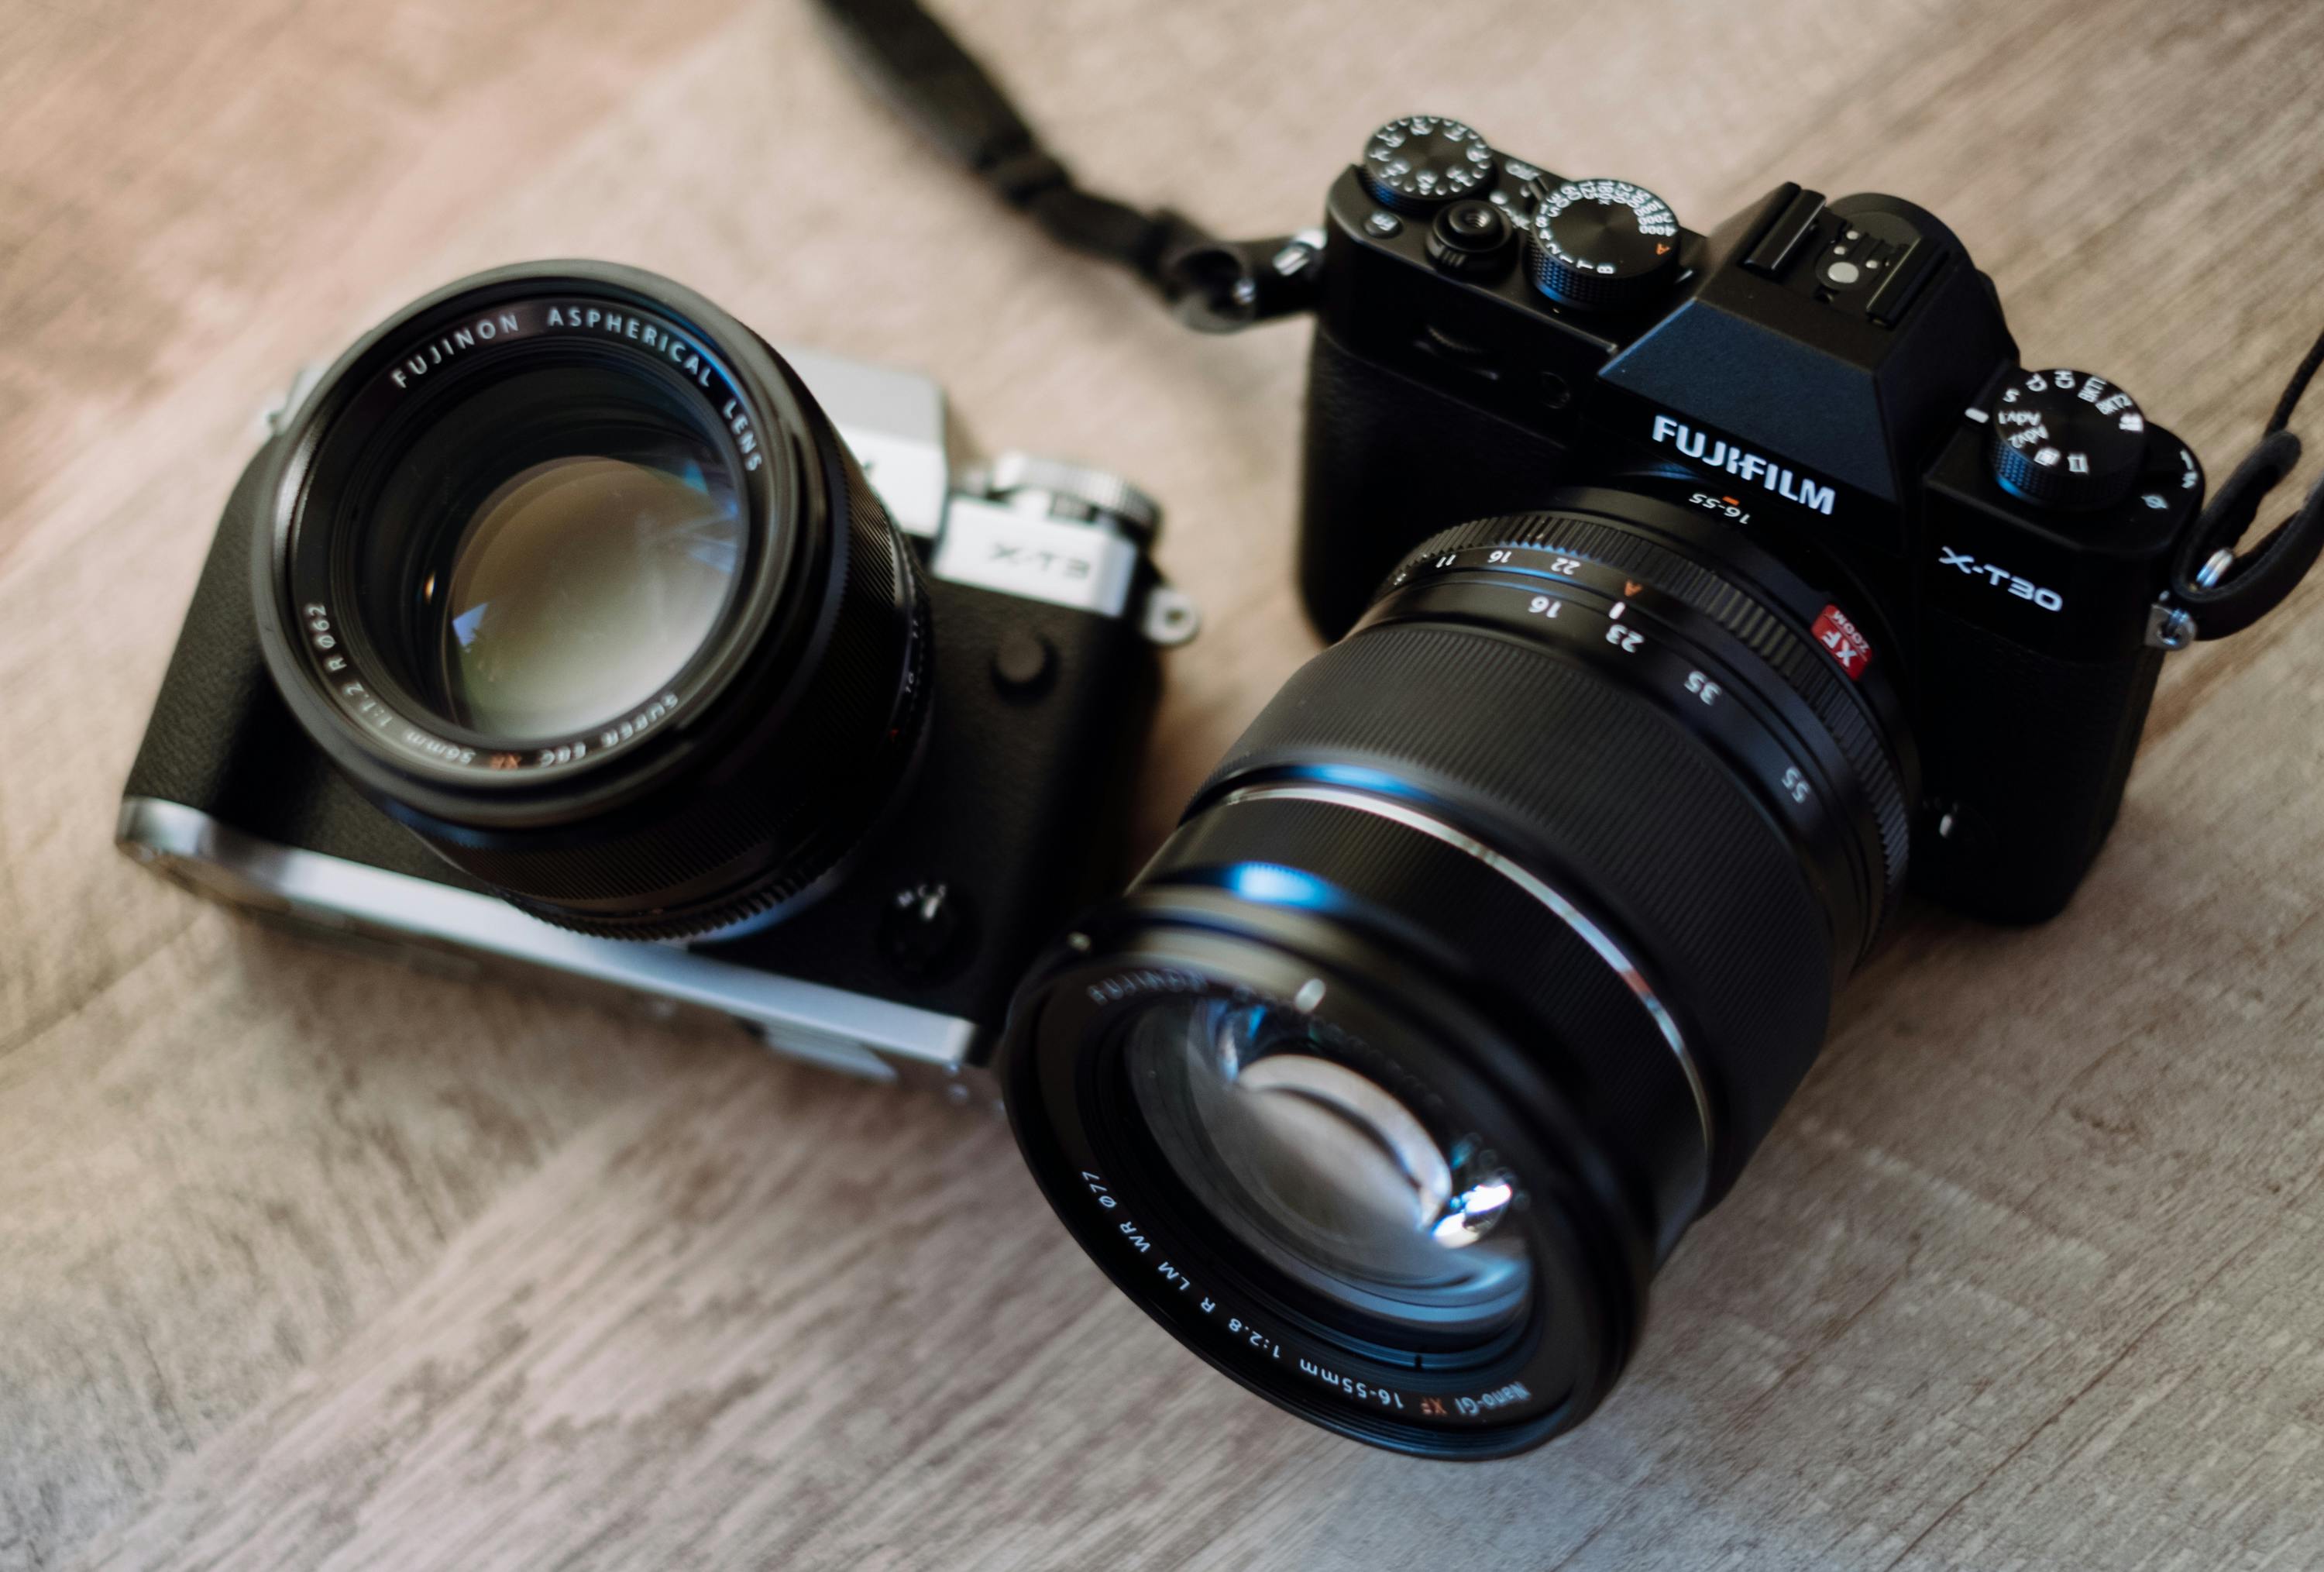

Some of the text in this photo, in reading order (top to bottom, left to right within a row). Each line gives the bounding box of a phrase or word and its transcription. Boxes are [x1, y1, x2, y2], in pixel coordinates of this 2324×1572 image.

[1546, 193, 1571, 208] 30
[1561, 183, 1583, 201] 60
[1579, 181, 1597, 199] 125
[1612, 183, 1634, 204] 250
[1626, 189, 1652, 208] 500
[1540, 203, 1562, 218] 15
[1634, 201, 1666, 218] 1000
[1637, 212, 1673, 225] 2000
[1535, 215, 1549, 228] 8
[1638, 225, 1677, 236] 4000
[1539, 229, 1552, 240] 4
[1546, 243, 1562, 254] 2
[1655, 243, 1670, 256] A
[1597, 264, 1615, 274] B
[390, 306, 765, 473] FUJINON ASPHERICAL LENS
[2003, 388, 2021, 403] S
[1652, 414, 1836, 515] FUJIFILM
[1687, 492, 1752, 526] 16-55
[989, 542, 1092, 579] X-T3
[1435, 554, 1456, 569] 11
[1487, 550, 1512, 563] 16
[1550, 557, 1581, 575] 22
[1624, 580, 1643, 597] A
[1938, 546, 2063, 613] X-T30
[1528, 596, 1562, 618] 16
[1605, 622, 1645, 655] 23
[1834, 610, 1870, 653] ZOOM
[1822, 630, 1858, 668] XF
[325, 655, 349, 673] R
[1684, 670, 1723, 706] 35
[342, 680, 395, 728] 1:1.2
[600, 691, 679, 749] SUPER
[404, 728, 477, 765] 56mm
[1780, 765, 1812, 805] 55
[1086, 968, 1208, 1006] FUJINON
[1119, 1221, 1151, 1254] WR
[1157, 1262, 1191, 1292] LM
[1201, 1296, 1217, 1314] R
[1227, 1317, 1281, 1360] 1:2.8
[1299, 1358, 1404, 1410] 16-55mm
[1419, 1396, 1447, 1417] XF
